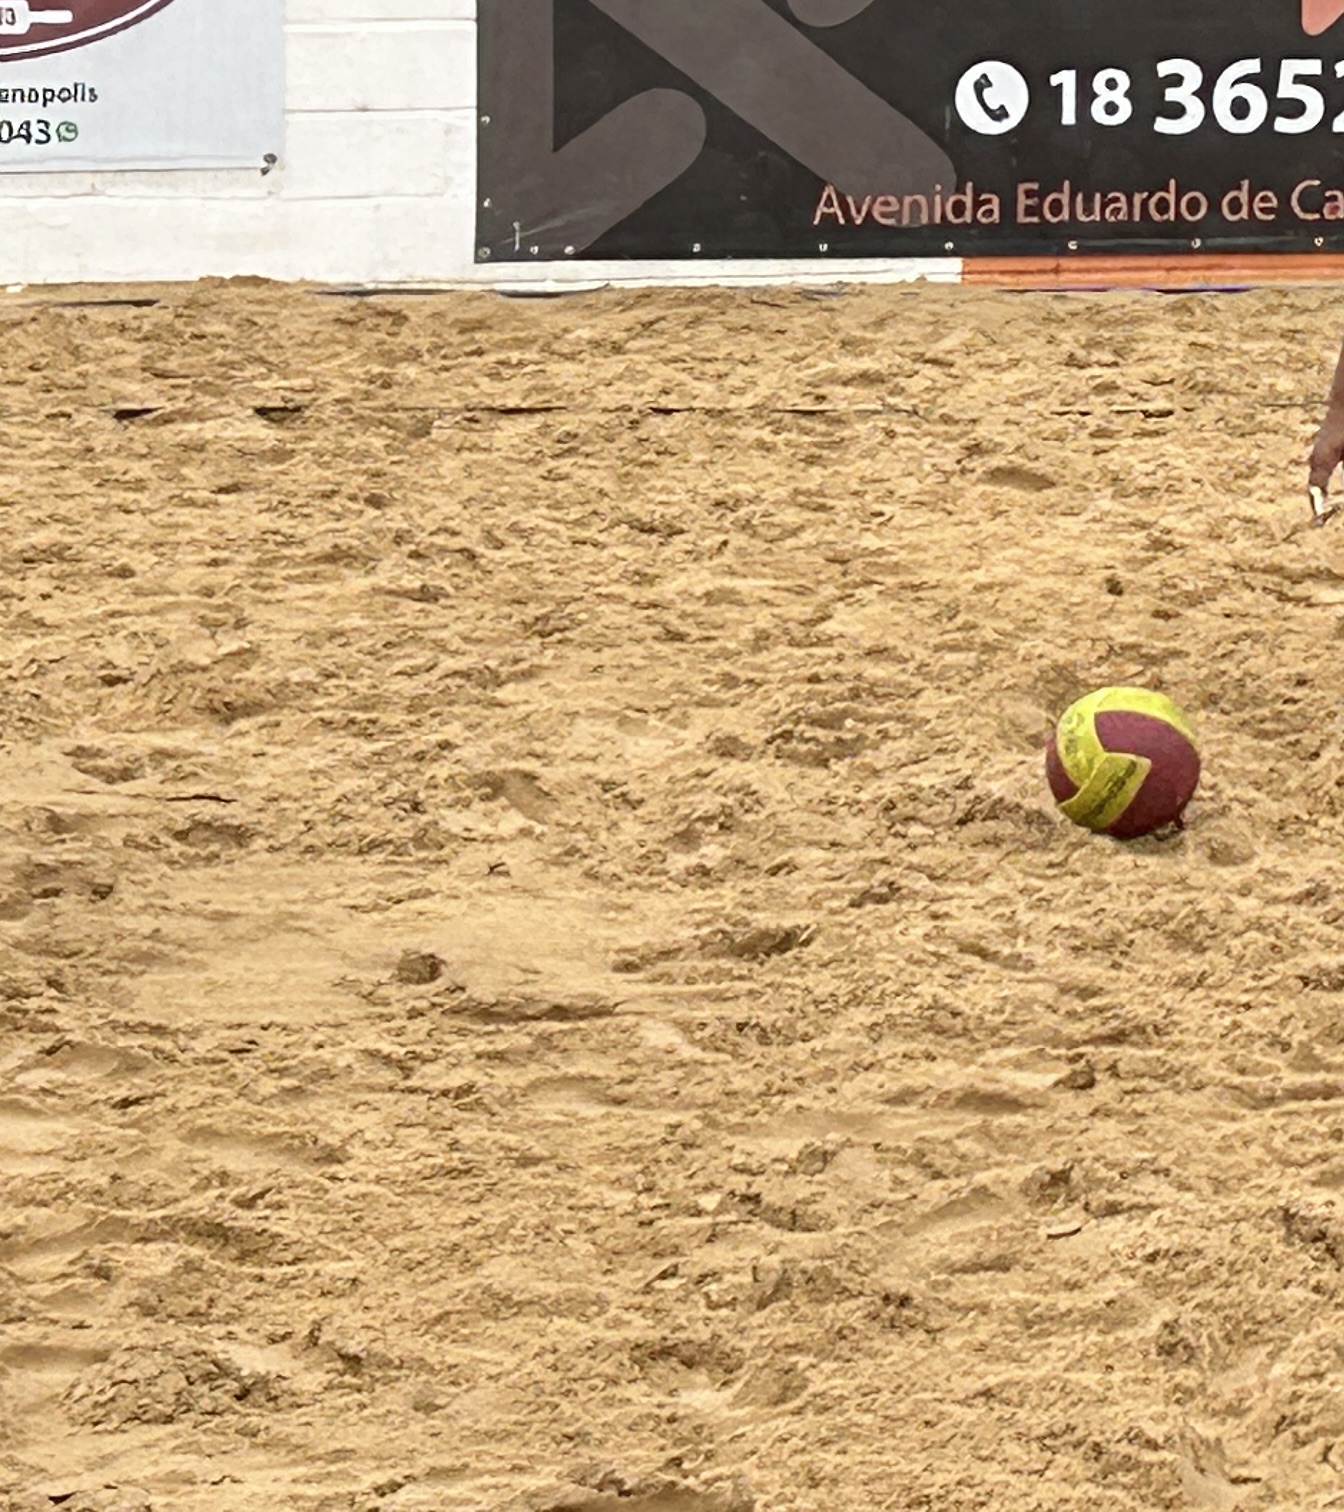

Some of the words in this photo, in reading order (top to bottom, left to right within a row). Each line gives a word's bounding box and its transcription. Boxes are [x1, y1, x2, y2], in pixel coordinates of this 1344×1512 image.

[1050, 68, 1133, 127] 18
[813, 182, 1000, 226] Avenida
[1016, 178, 1209, 224] Eduardo
[1221, 179, 1279, 222] de
